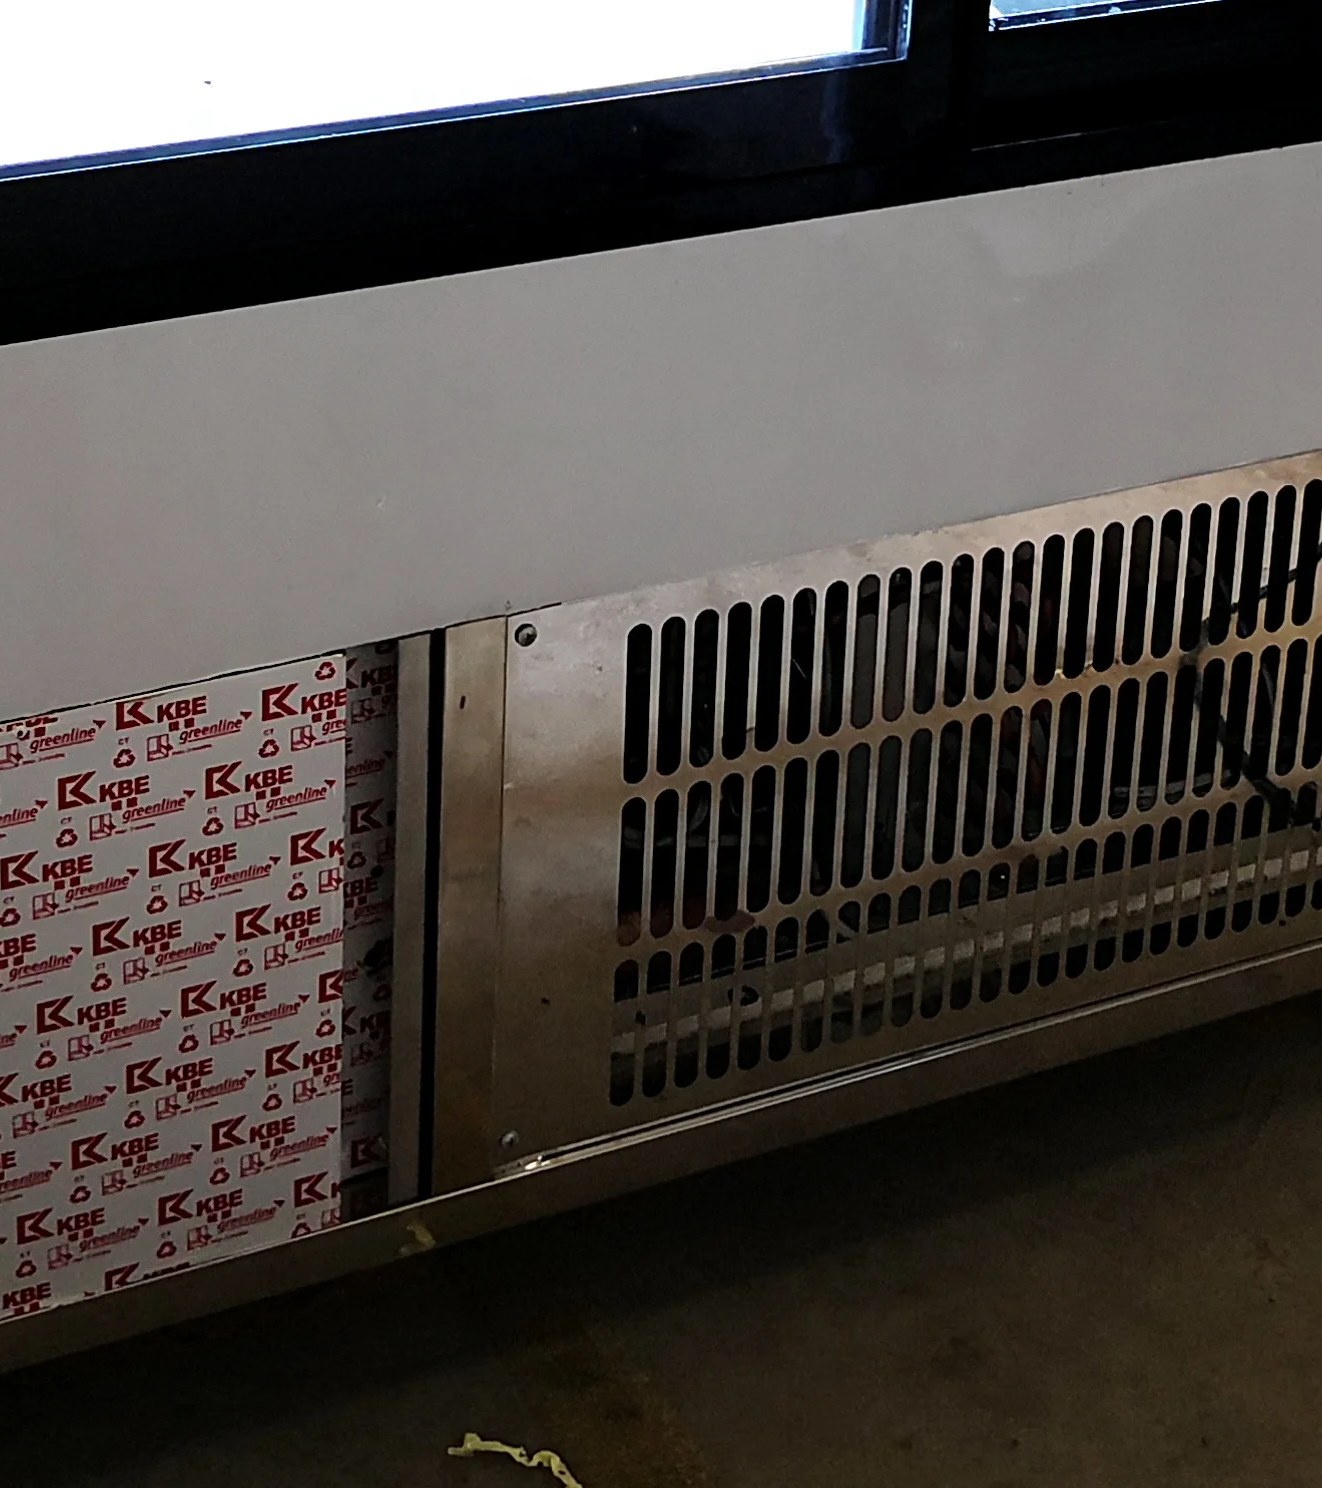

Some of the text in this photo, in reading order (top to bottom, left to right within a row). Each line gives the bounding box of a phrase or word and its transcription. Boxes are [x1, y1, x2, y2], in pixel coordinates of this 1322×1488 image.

[157, 695, 207, 723] KBE
[30, 725, 96, 752] greenline
[179, 718, 243, 743] greenline
[99, 775, 150, 803] KBE
[245, 765, 293, 792] KBE
[122, 797, 186, 823] greenline
[266, 787, 327, 812] greenline
[42, 854, 93, 882] KBE
[188, 843, 237, 870] KBE
[65, 875, 129, 902] greenline
[211, 862, 272, 889] greenline
[133, 920, 182, 947] KBE
[274, 907, 321, 933] KBE
[156, 939, 218, 964] greenline
[9, 952, 73, 981] greenline
[219, 982, 267, 1009] KBE
[77, 997, 127, 1025] KBE
[241, 1001, 301, 1028] greenline
[100, 1016, 163, 1043] greenline
[165, 1058, 213, 1085] KBE
[21, 1074, 71, 1102] KBE
[187, 1076, 248, 1103] greenline
[45, 1092, 107, 1120] greenline
[249, 1115, 296, 1143] KBE
[111, 1133, 159, 1161] KBE
[270, 1134, 328, 1161] greenline
[133, 1151, 193, 1177] greenline
[196, 1189, 243, 1217] KBE
[57, 1207, 105, 1235] KBE
[2, 1282, 52, 1309] KBE
